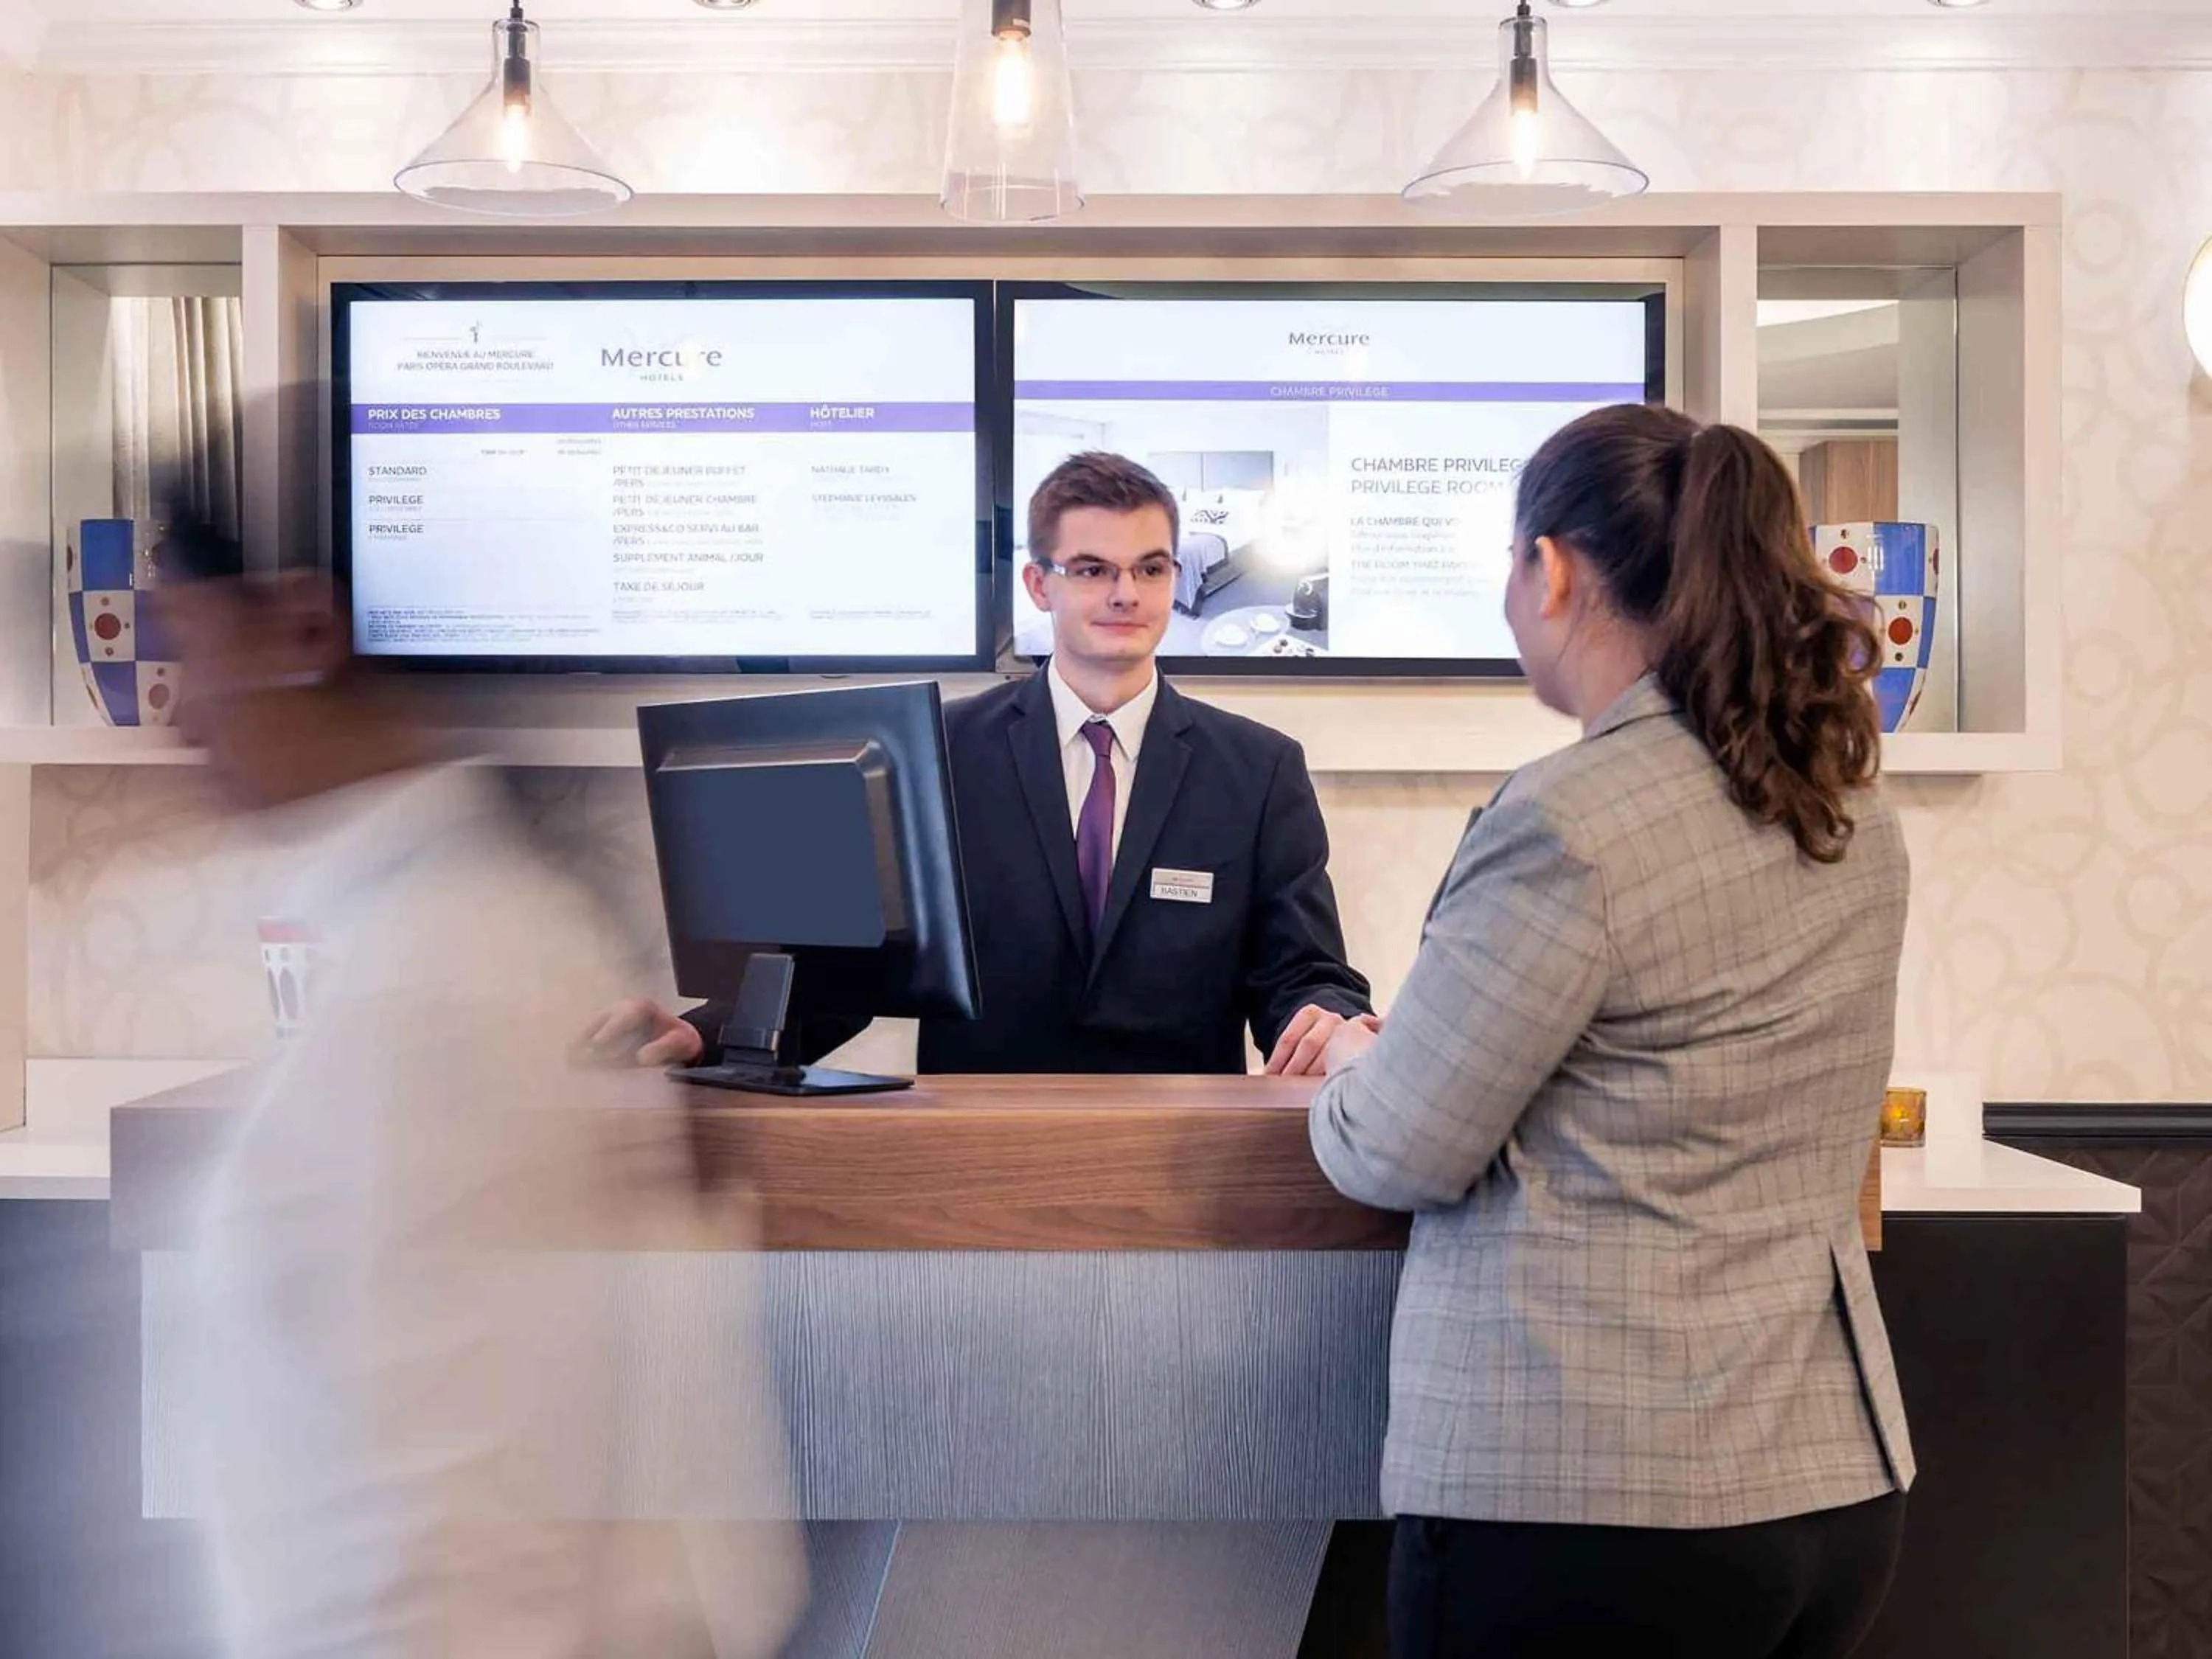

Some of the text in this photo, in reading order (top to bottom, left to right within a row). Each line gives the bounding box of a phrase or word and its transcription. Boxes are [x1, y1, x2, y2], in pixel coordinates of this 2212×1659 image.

[1289, 332, 1371, 346] Mercure
[639, 373, 684, 382] HOTELS
[1270, 386, 1391, 397] CHAMBRE PRIVILEGE
[368, 408, 501, 420] PRIX DES CHAMBRES
[613, 408, 756, 420] AUTRES PRESTATIONS
[810, 404, 875, 419] HÔTELIER
[368, 465, 428, 476] STANDARD
[1351, 457, 1528, 473] CHAMBRE PRIVILEG
[1351, 479, 1441, 495] PRIVILEGE
[368, 495, 424, 505] PRIVILEGE
[705, 495, 757, 504] CHAMBRE
[1350, 516, 1364, 527] LA
[1366, 516, 1419, 527] CHAMBRE
[1422, 516, 1443, 527] QUI
[368, 524, 425, 534] PRIVILEGE
[737, 524, 759, 533] BAR
[687, 553, 728, 563] ANIMAL
[613, 582, 641, 592] TAXE
